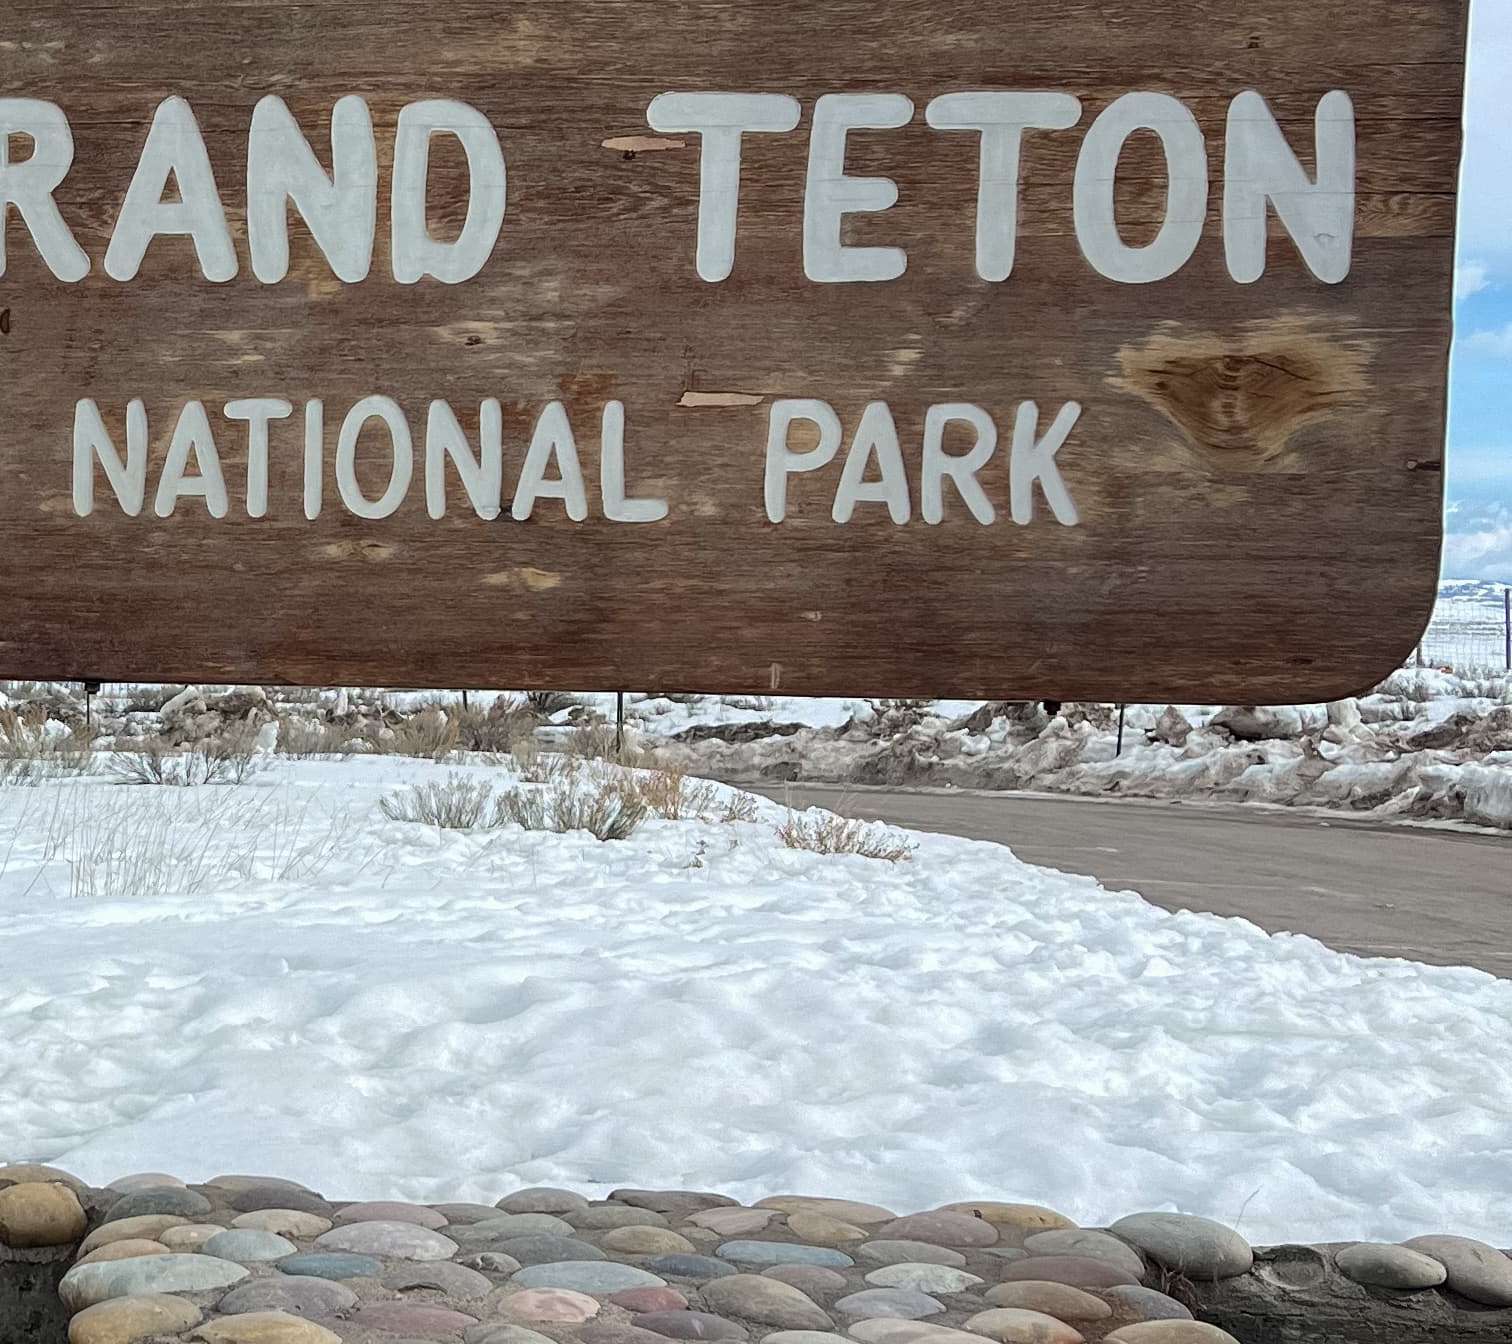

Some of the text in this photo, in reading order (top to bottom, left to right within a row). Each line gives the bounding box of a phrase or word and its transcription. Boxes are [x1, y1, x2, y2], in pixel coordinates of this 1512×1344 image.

[645, 89, 1356, 285] TETON
[71, 394, 1082, 526] NATIONAL PARK
